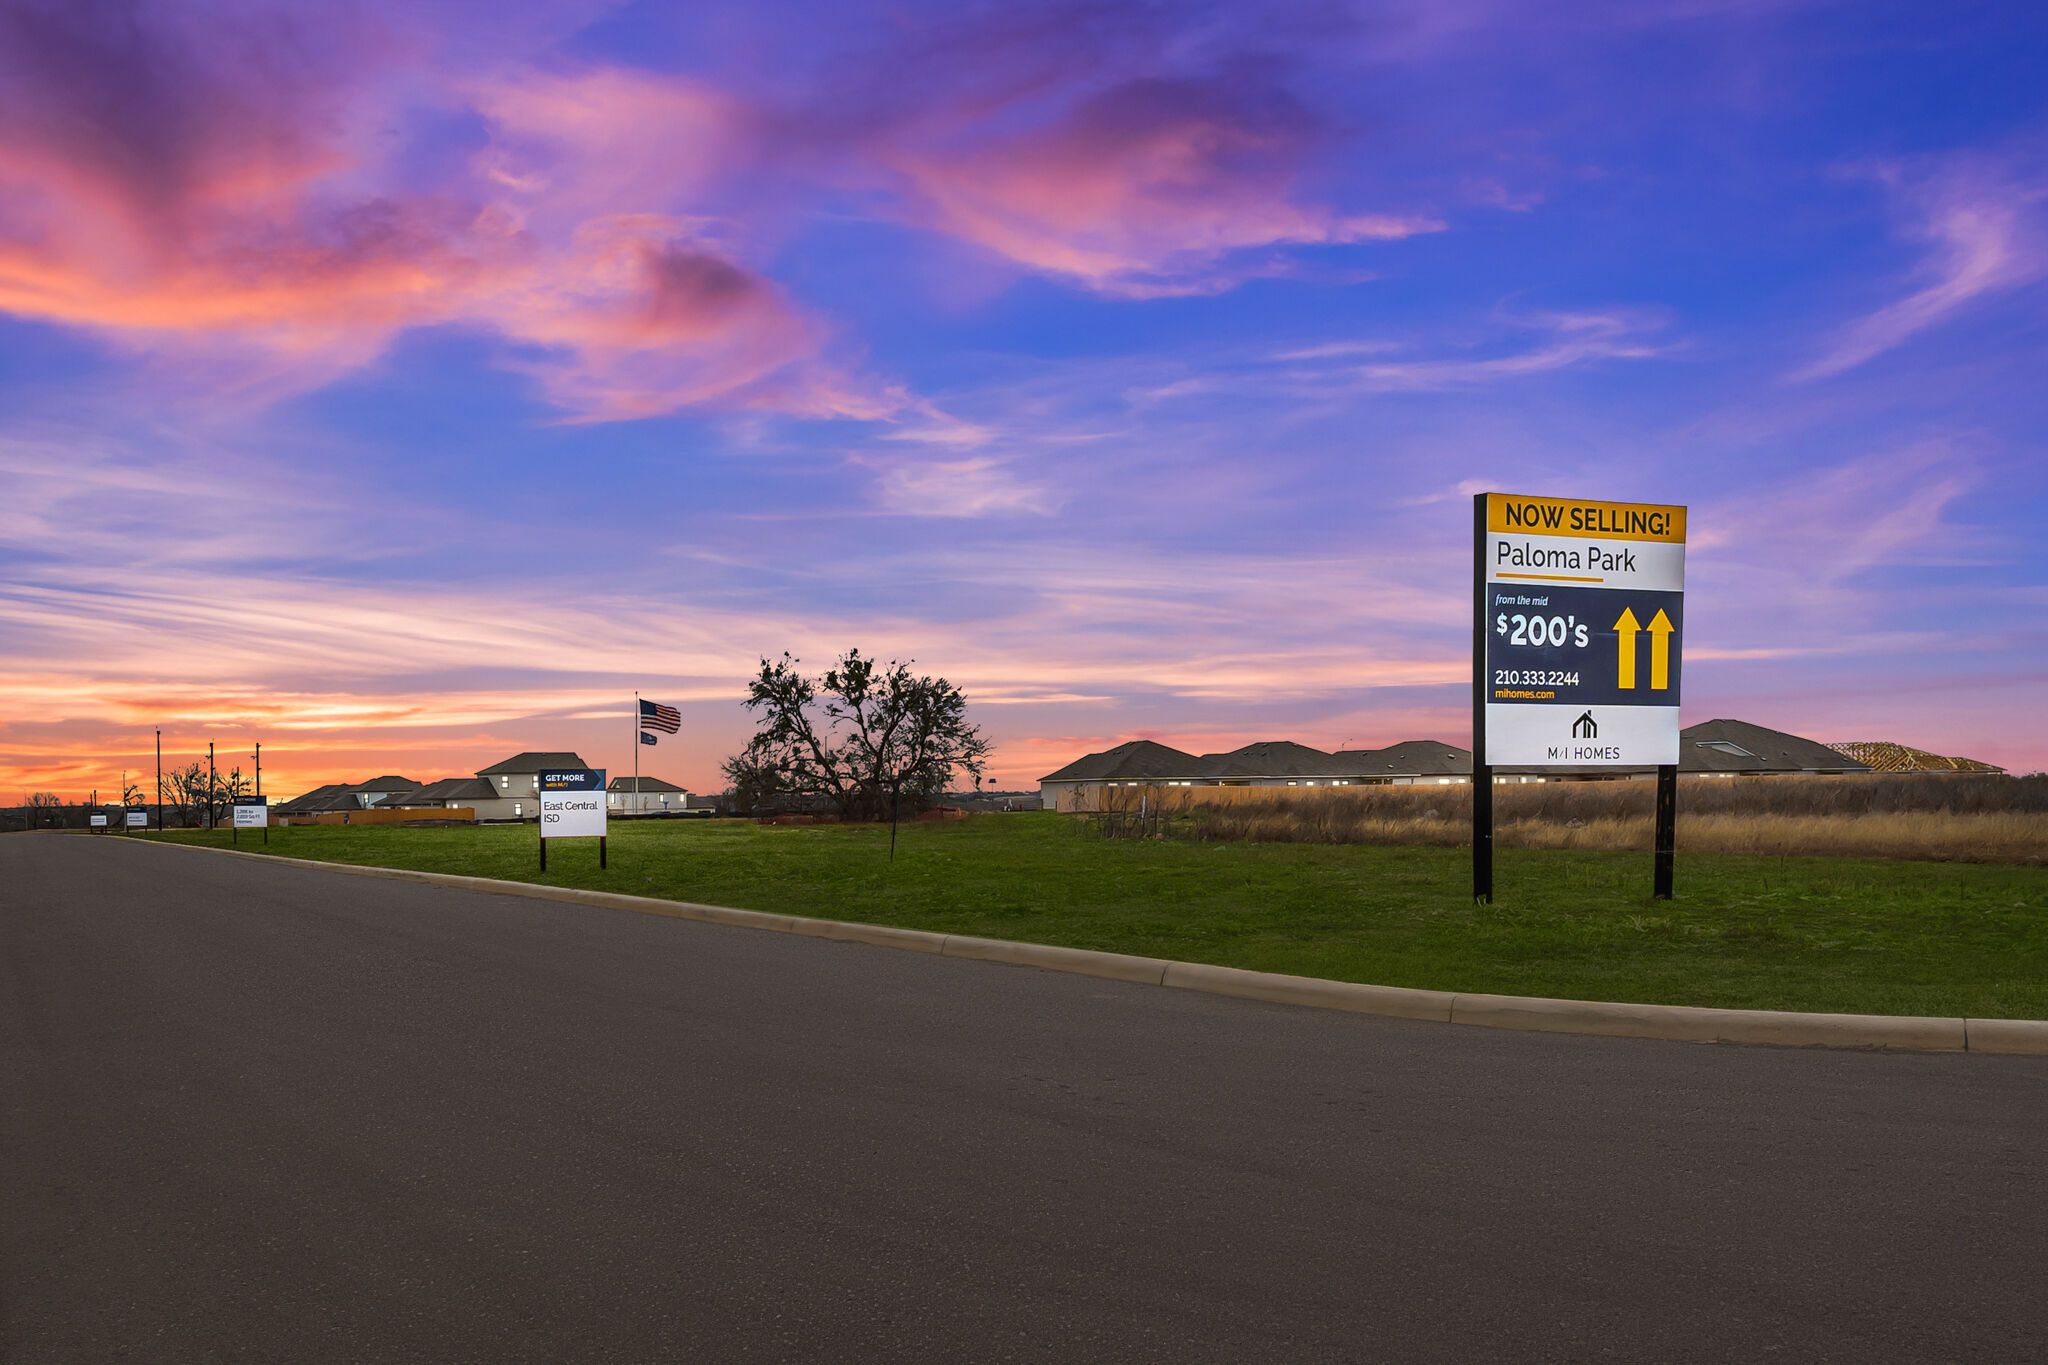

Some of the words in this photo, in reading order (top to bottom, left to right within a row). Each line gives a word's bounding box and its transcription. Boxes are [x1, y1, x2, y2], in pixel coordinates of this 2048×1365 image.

[1506, 502, 1564, 528] NOW
[1570, 507, 1671, 535] SELLING!
[1497, 541, 1581, 569] Paloma
[1588, 546, 1636, 572] Park
[1495, 593, 1516, 606] from
[1517, 594, 1531, 606] the
[1531, 596, 1549, 606] mid
[1496, 612, 1589, 648] $200's
[1495, 670, 1580, 686] 210.333.2244
[1495, 688, 1555, 700] mihomes.com
[1574, 747, 1620, 760] HOMES
[545, 774, 561, 782] GET
[562, 774, 584, 782] MORE
[544, 801, 563, 811] East
[565, 801, 598, 811] Central
[544, 813, 560, 823] ISD
